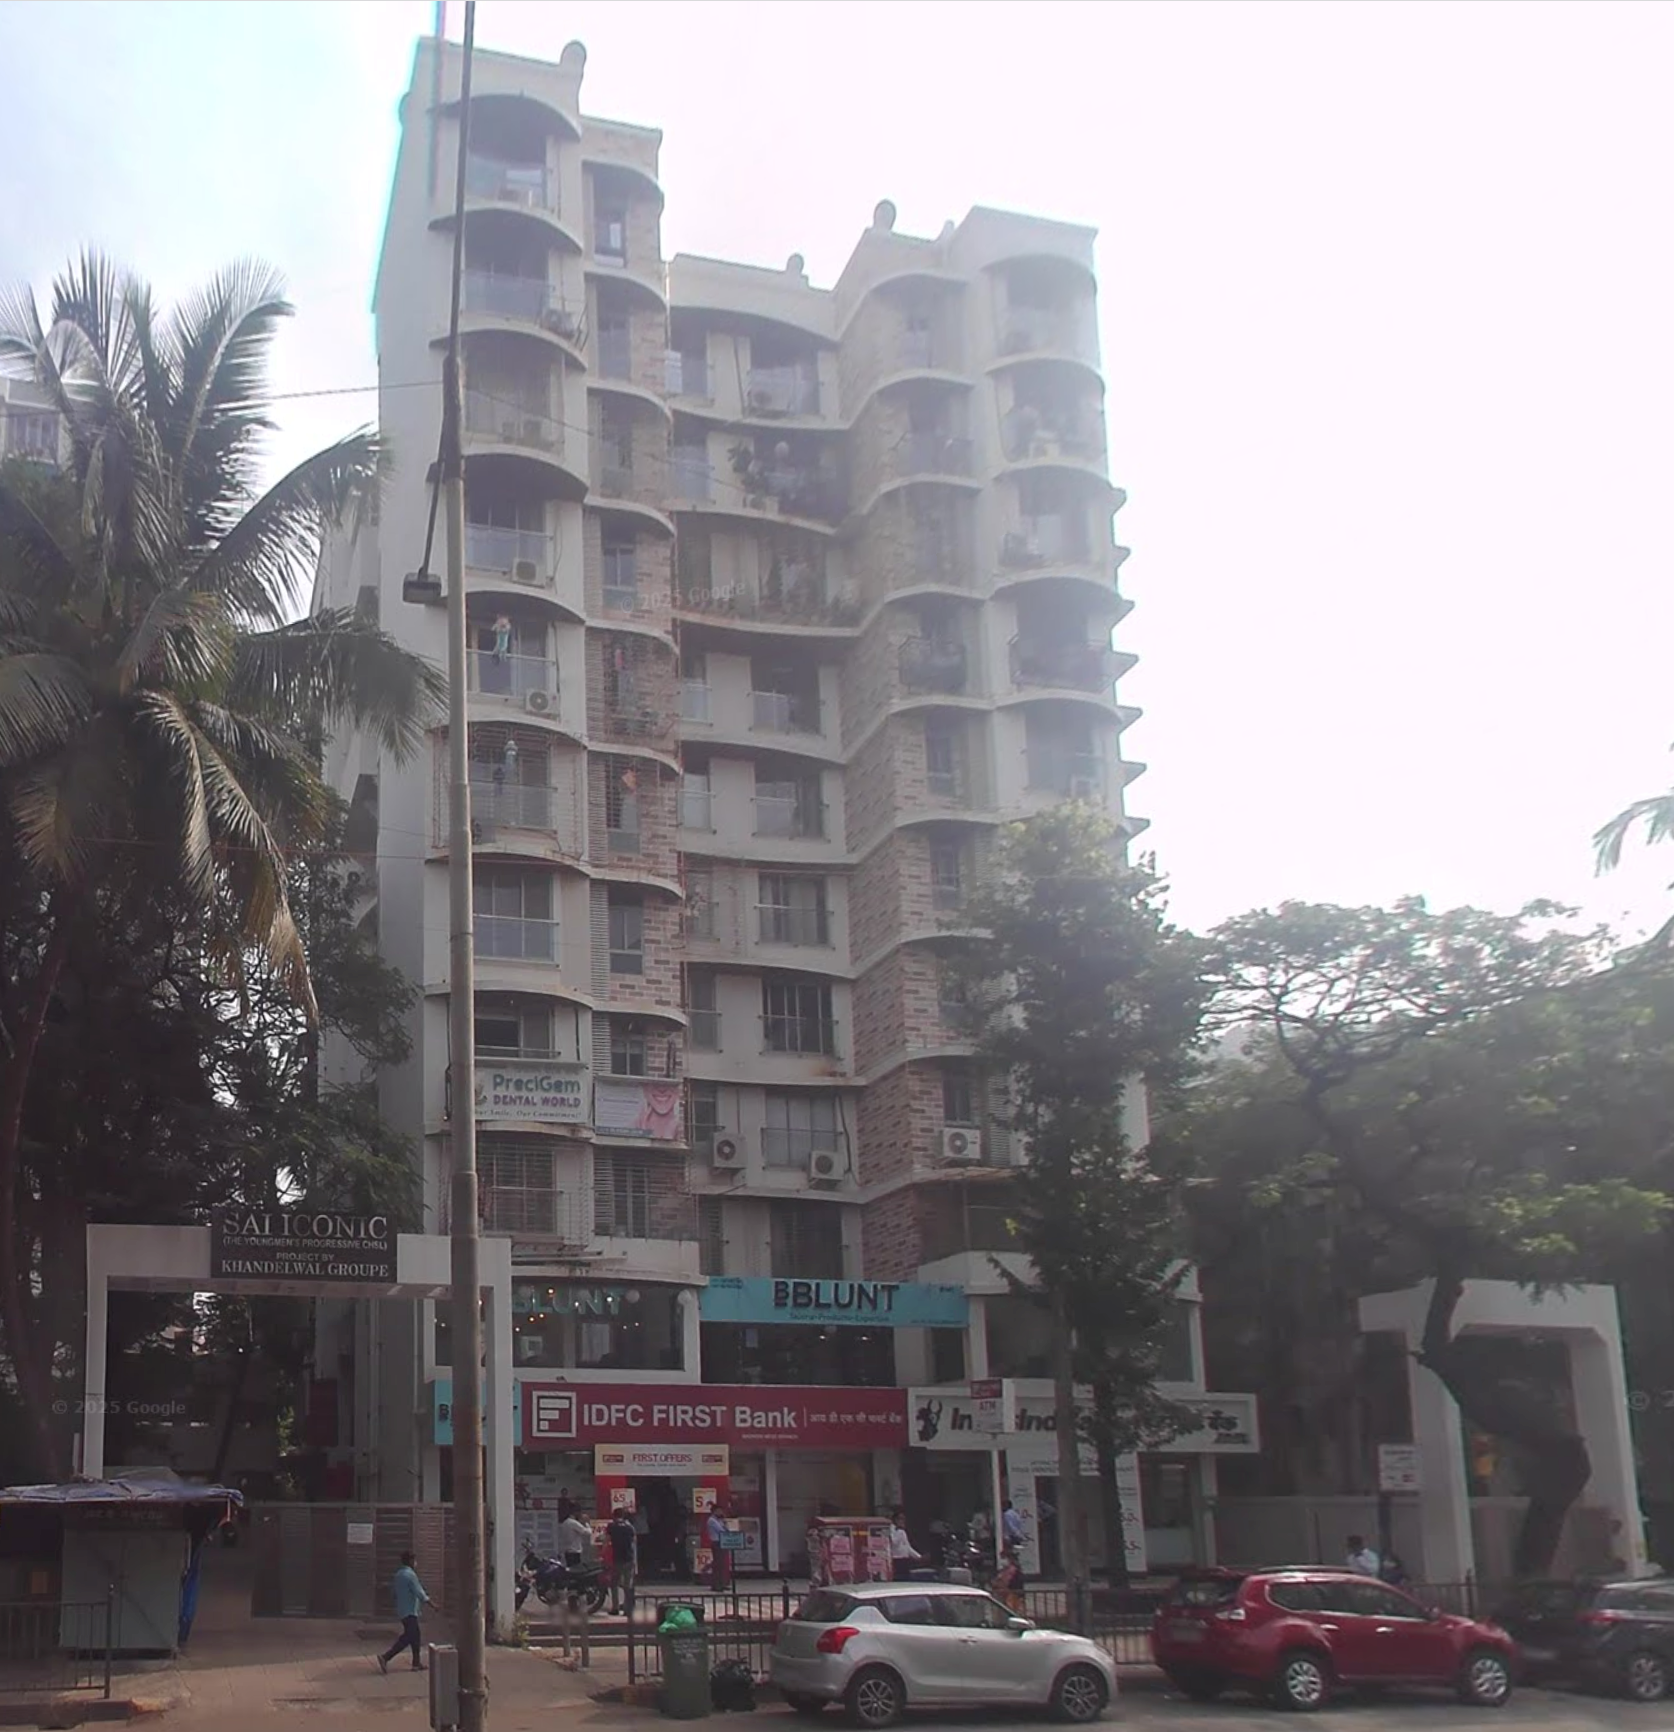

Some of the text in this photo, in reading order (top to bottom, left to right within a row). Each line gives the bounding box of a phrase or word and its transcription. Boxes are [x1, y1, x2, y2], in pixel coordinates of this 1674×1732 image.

[493, 1094, 538, 1108] DENTAL
[540, 1096, 582, 1108] WORLD
[222, 1211, 388, 1239] SAI ICONIC
[244, 1236, 300, 1248] YOUNGMEN'S
[302, 1238, 361, 1249] PROGRESSIVE
[276, 1251, 335, 1262] PROJECT BY
[221, 1260, 388, 1277] KHANDELWAL GROUPE
[773, 1280, 900, 1313] BBLUNT
[583, 1403, 644, 1427] IDFC
[652, 1404, 728, 1428] FIRST
[734, 1406, 797, 1429] Bank
[632, 1453, 659, 1463] FIRST
[660, 1453, 693, 1463] OFFERS
